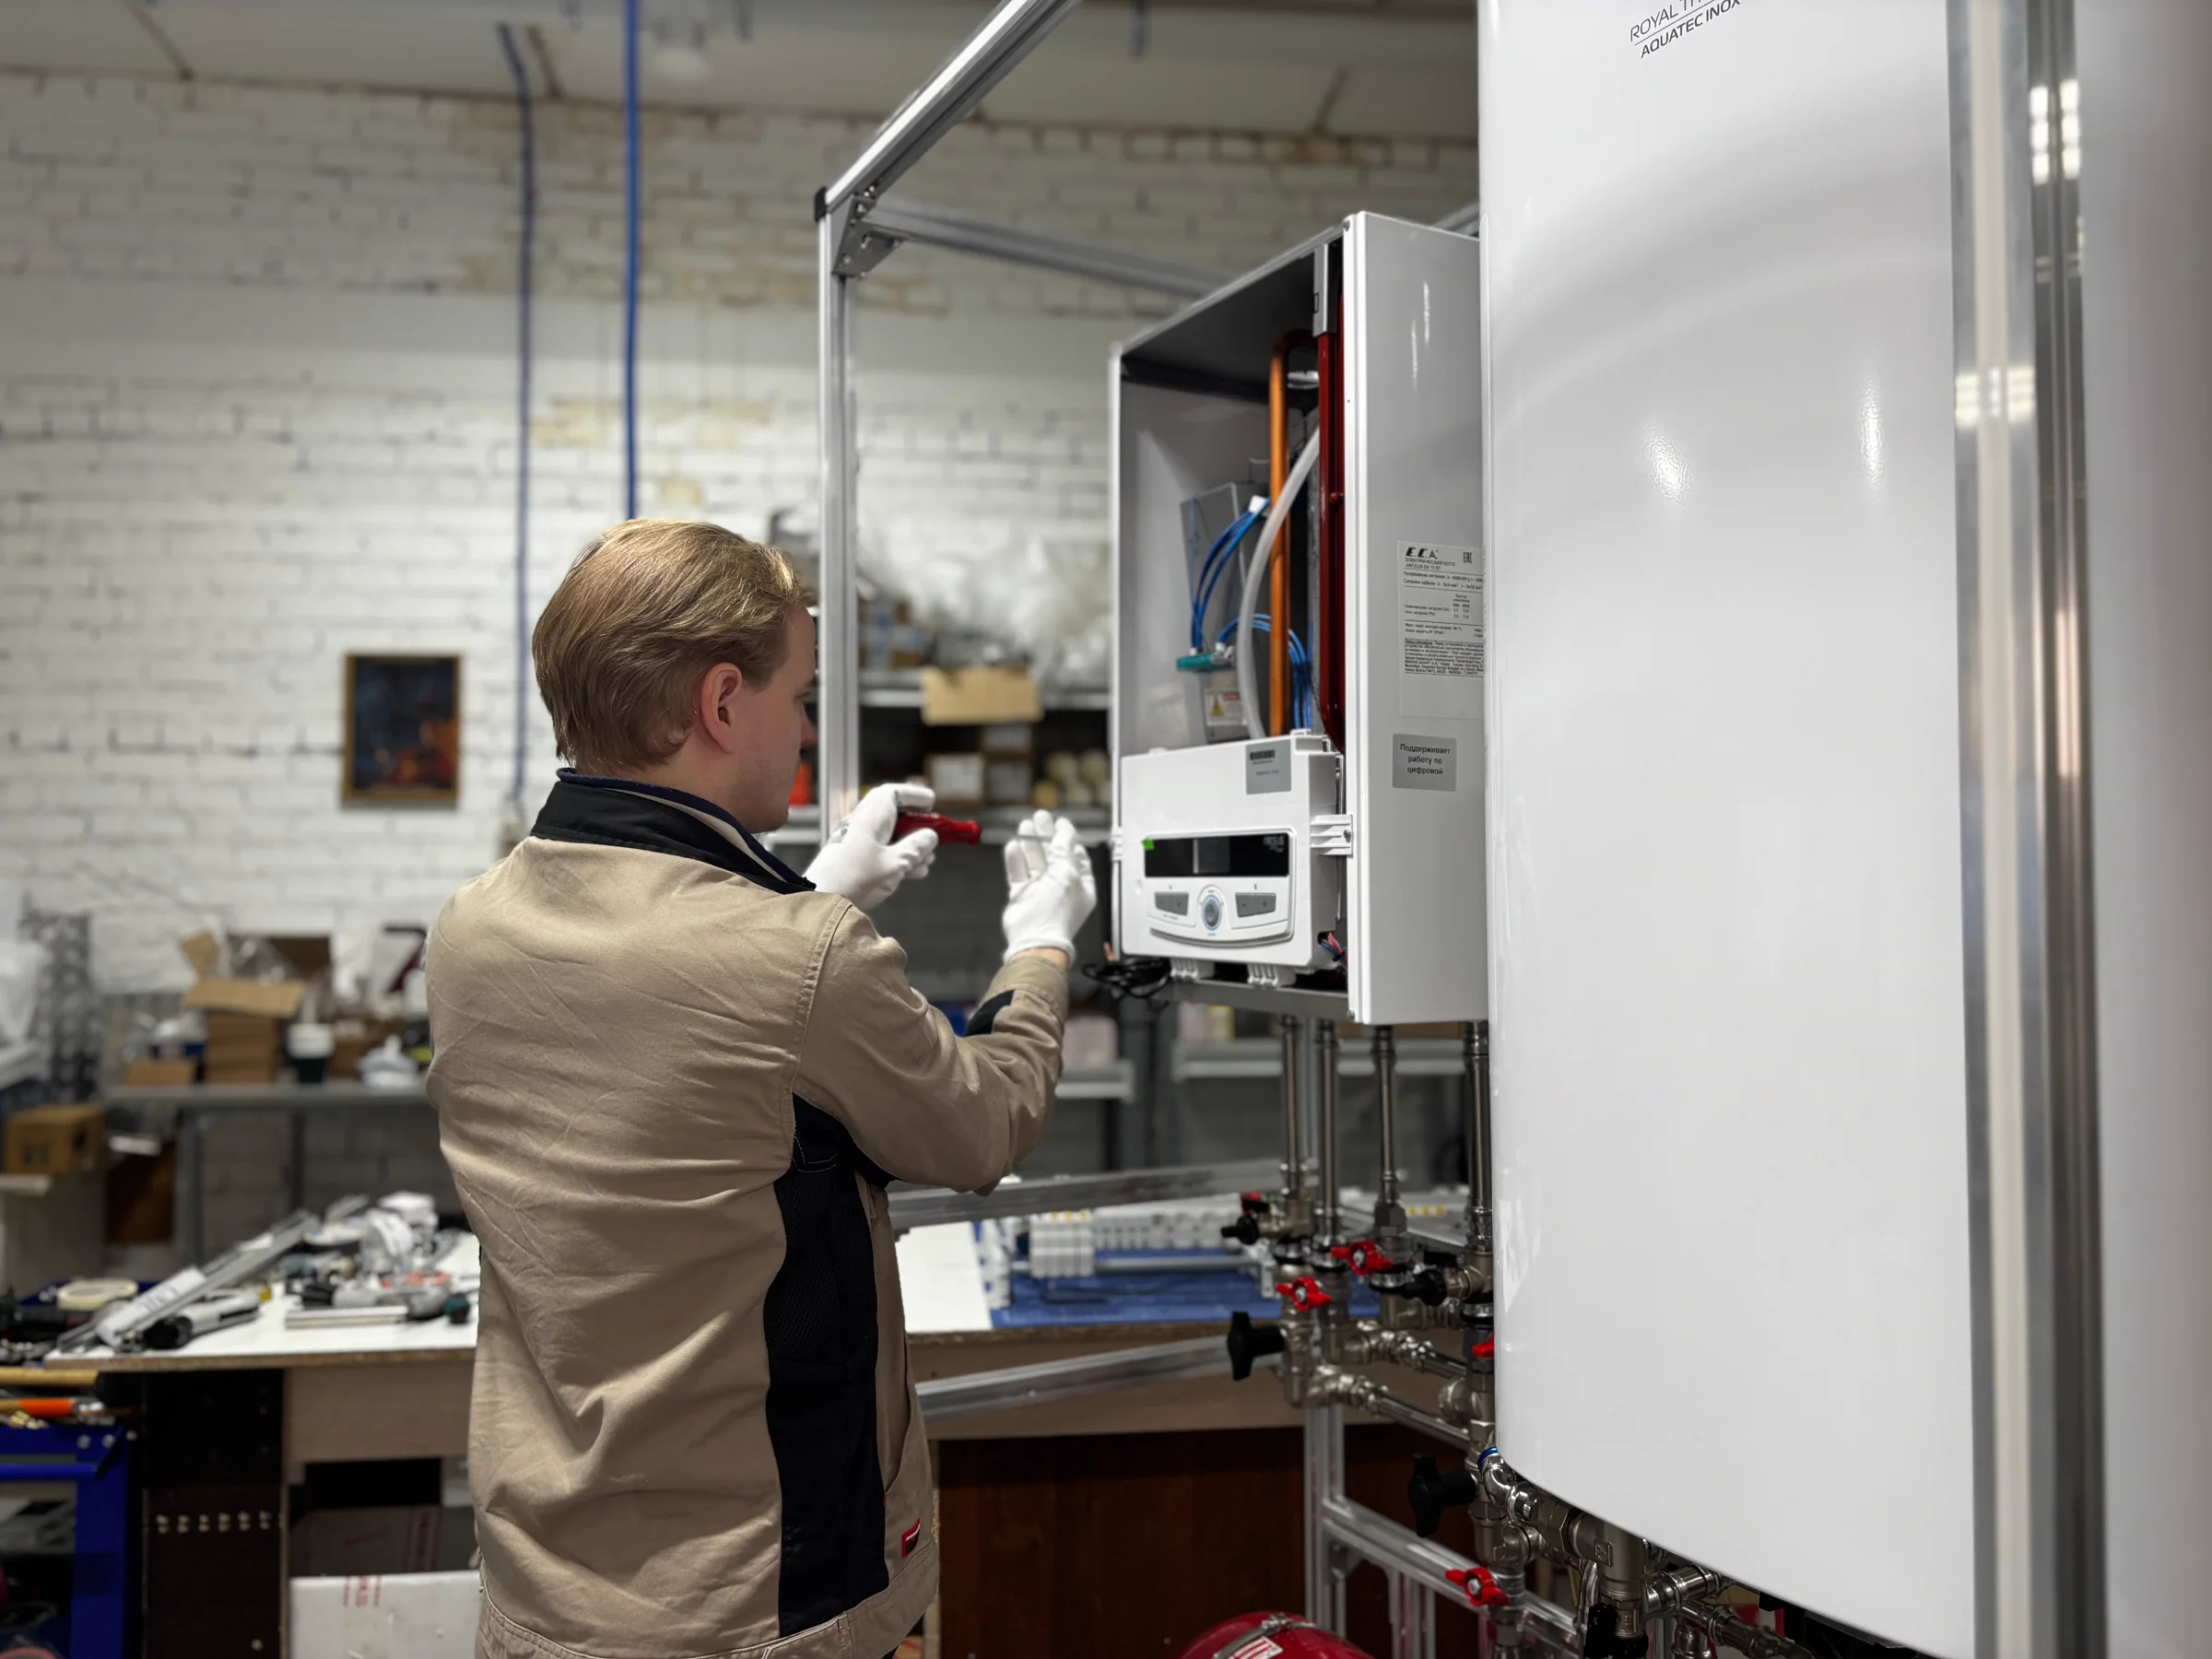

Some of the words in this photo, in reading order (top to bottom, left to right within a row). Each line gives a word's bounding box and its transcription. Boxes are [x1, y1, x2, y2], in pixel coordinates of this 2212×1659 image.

[1630, 4, 1678, 42] ROYAL
[1641, 13, 1703, 59] AQUATEC
[1706, 0, 1740, 22] INOX
[1400, 743, 1451, 755] Поддерживает
[1408, 756, 1432, 766] работу
[1406, 767, 1443, 775] цифровой
